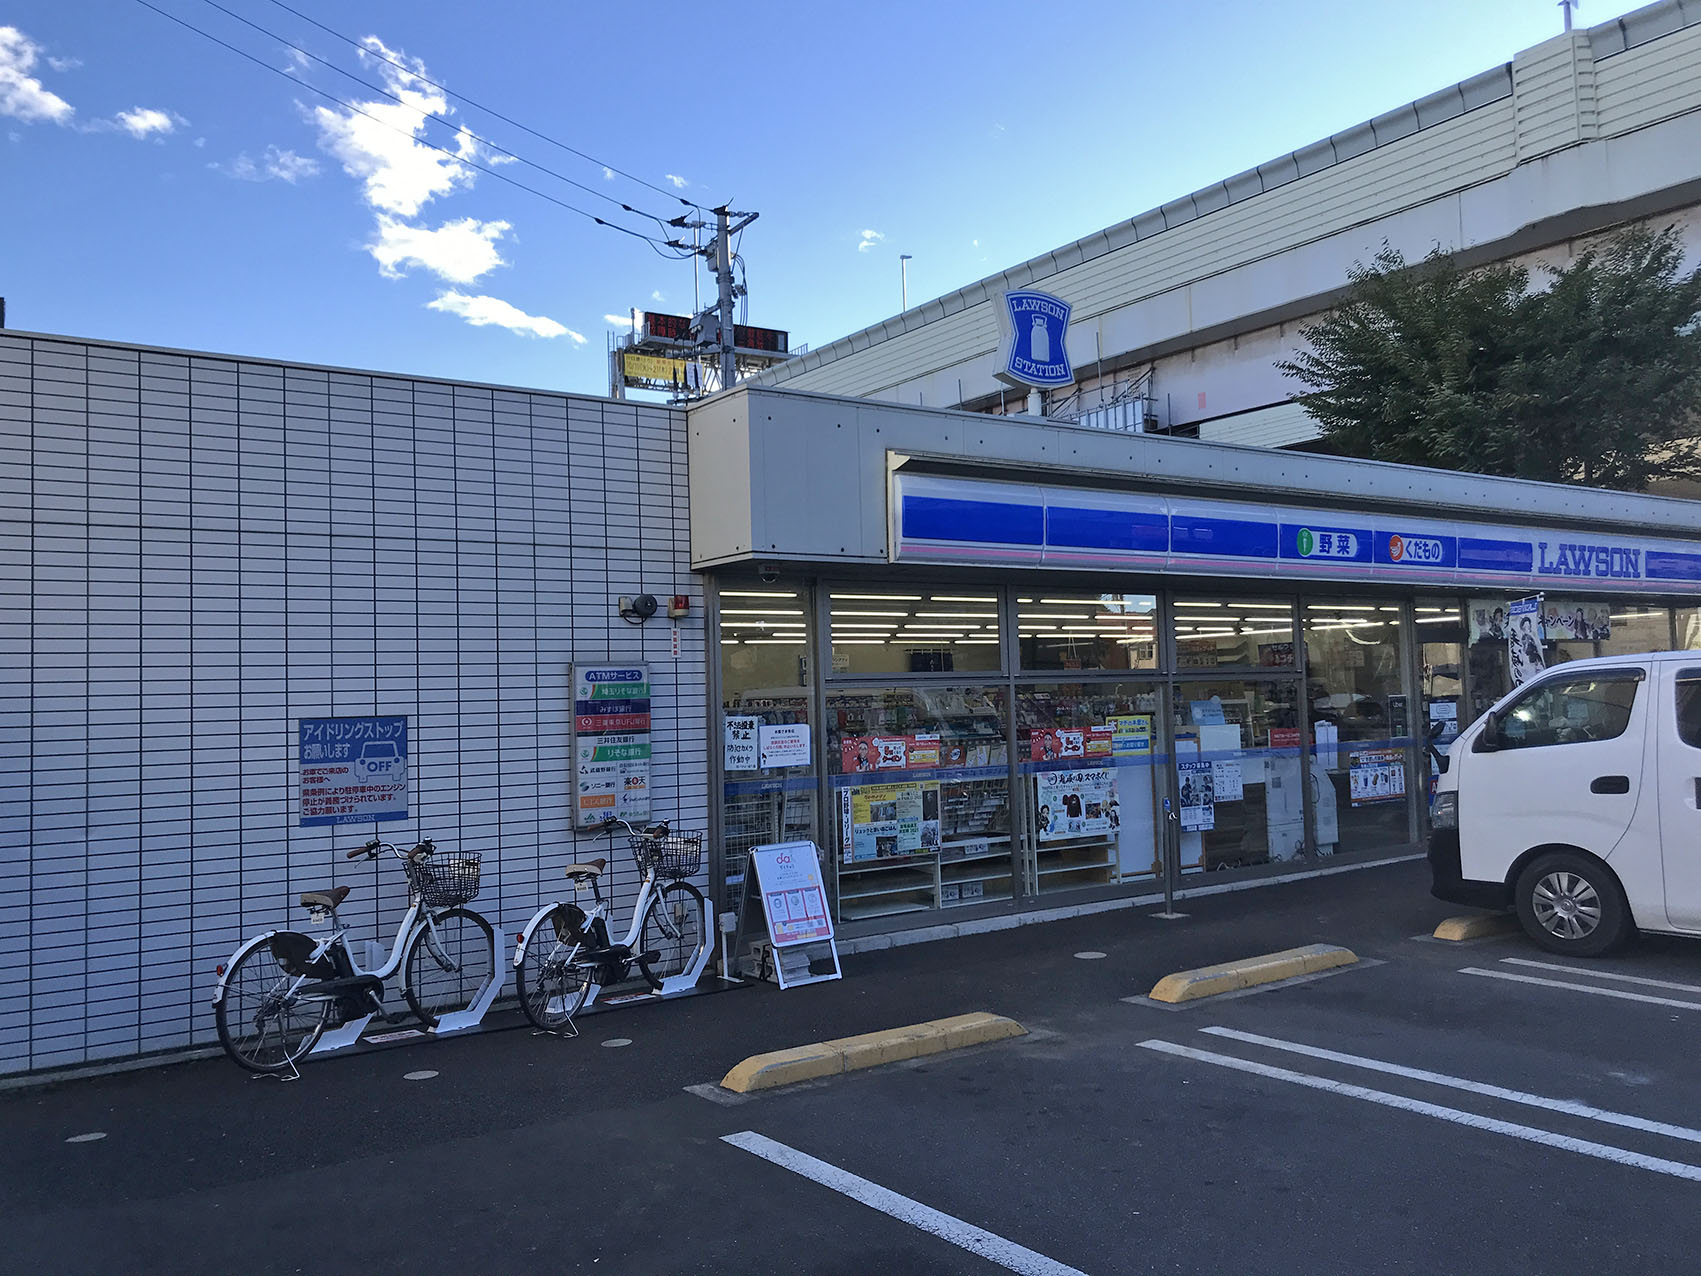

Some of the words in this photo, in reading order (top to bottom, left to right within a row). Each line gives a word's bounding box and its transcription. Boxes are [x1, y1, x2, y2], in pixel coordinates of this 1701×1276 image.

[1012, 299, 1065, 321] LAWSON
[1015, 356, 1066, 377] STATION
[1319, 533, 1351, 556] 野菜
[1405, 540, 1440, 561] くだもの
[1538, 542, 1641, 578] LAWSON
[588, 671, 640, 682] ATMサービス
[303, 721, 403, 741] アイドリングストップ
[732, 731, 752, 741] 禁止
[597, 735, 635, 745] 三井住友銀行
[303, 743, 350, 760] お願いします
[608, 747, 641, 758] りそな銀行
[303, 767, 350, 777] お車でご来店の
[367, 761, 392, 773] OFF
[1180, 762, 1210, 771] スタッフ募集中
[303, 776, 331, 786] お客様へ
[591, 781, 616, 790] ソニー銀行
[303, 805, 358, 816] ご協力願います。
[336, 814, 376, 824] LAWSON
